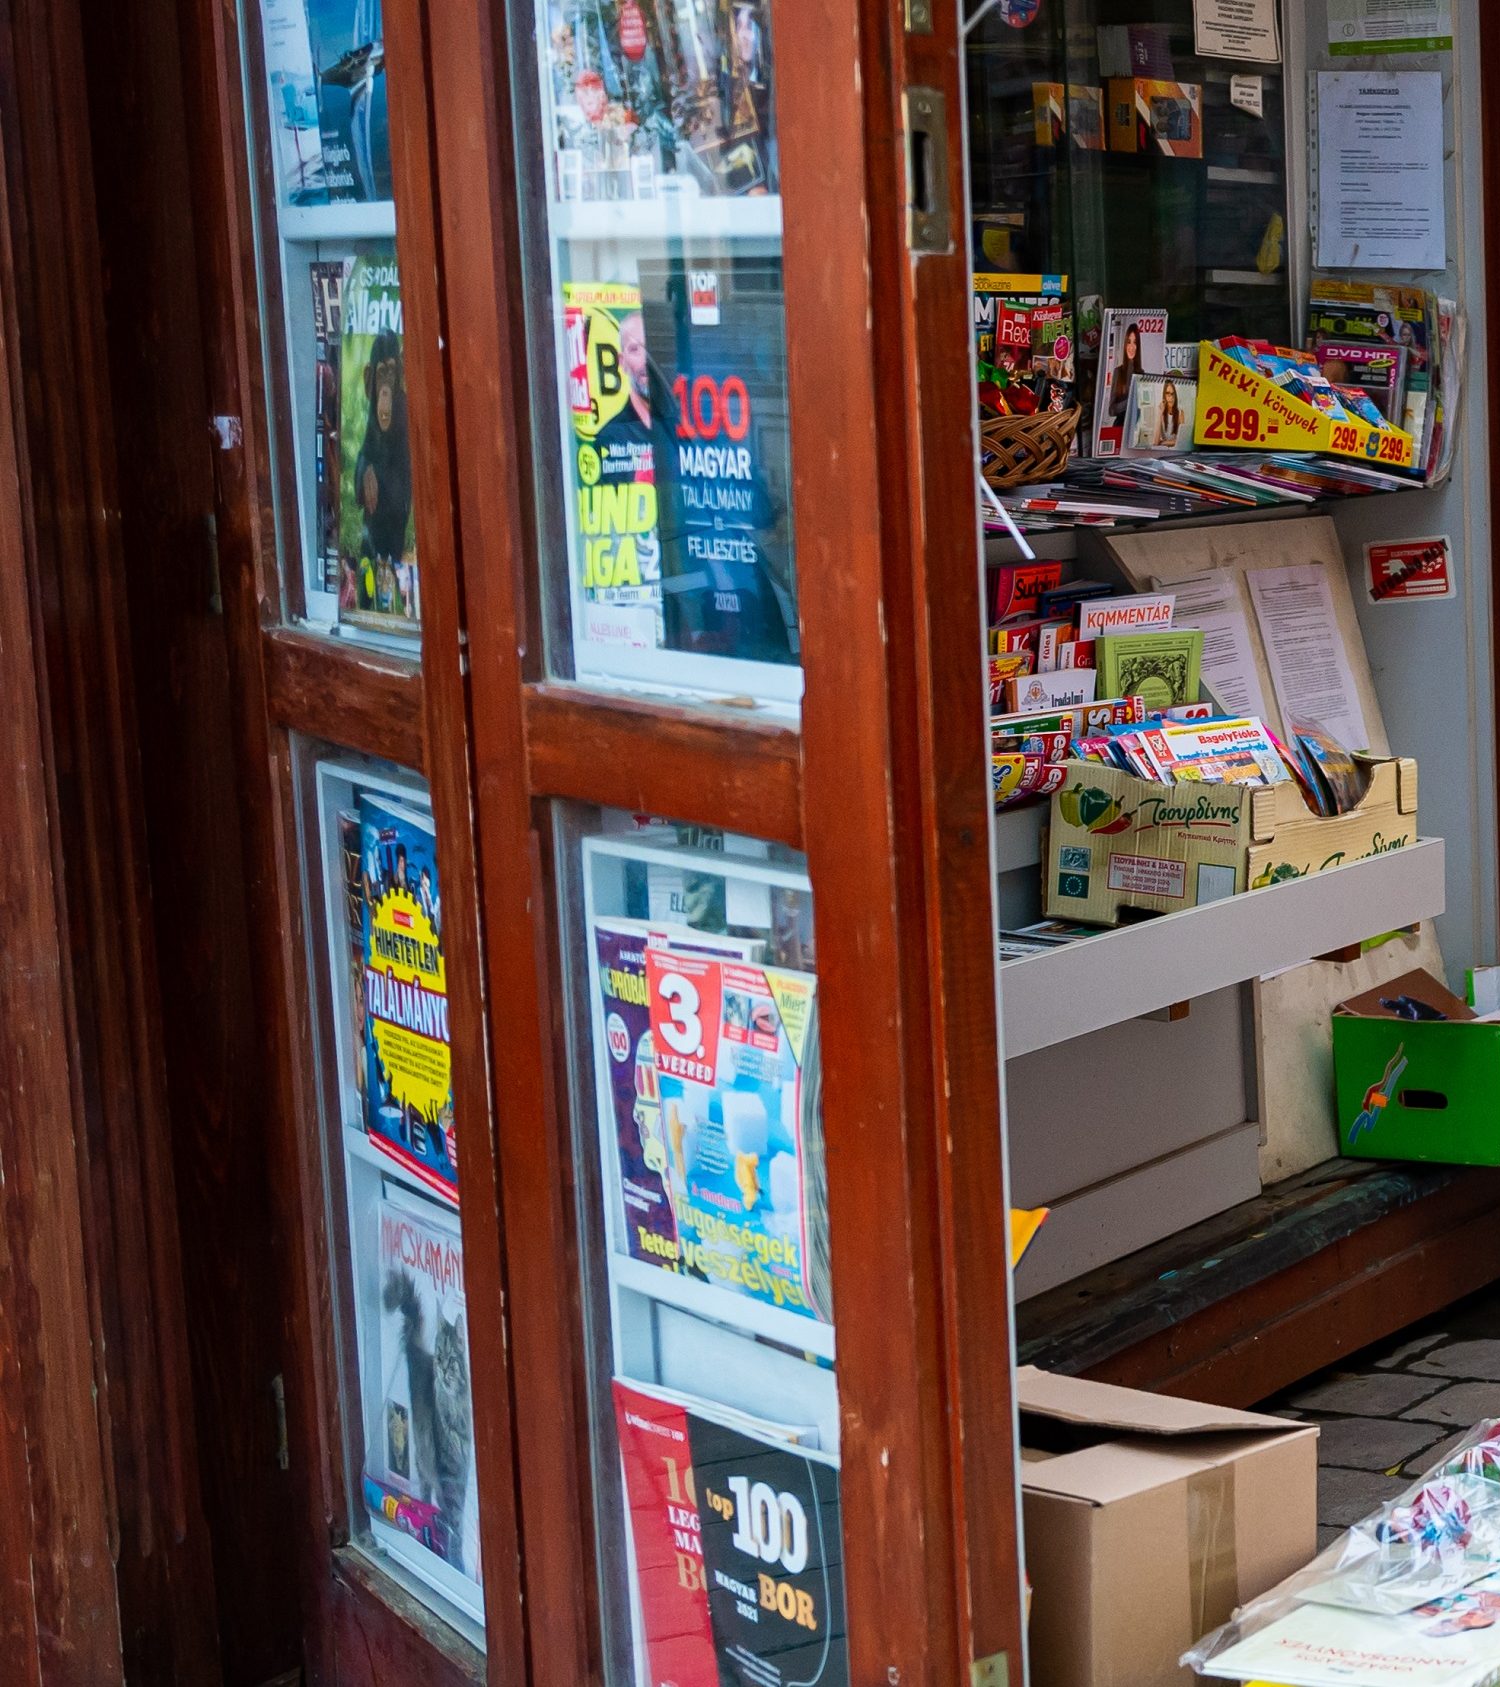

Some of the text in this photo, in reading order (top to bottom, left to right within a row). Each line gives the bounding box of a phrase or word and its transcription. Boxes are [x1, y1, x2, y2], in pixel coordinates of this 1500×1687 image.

[690, 275, 718, 292] TOP
[1042, 279, 1062, 292] olive
[1139, 319, 1164, 333] 2022
[1326, 347, 1363, 359] DVD
[673, 373, 750, 441] 100
[1263, 389, 1319, 435] könyvek
[679, 445, 752, 480] MAGYAR
[1087, 602, 1171, 628] KOMMENTÁR
[1197, 729, 1261, 745] BagolyFióka
[374, 928, 441, 976] HIHETETLEN
[705, 1475, 808, 1575] top 100
[758, 1572, 818, 1632] BOR
